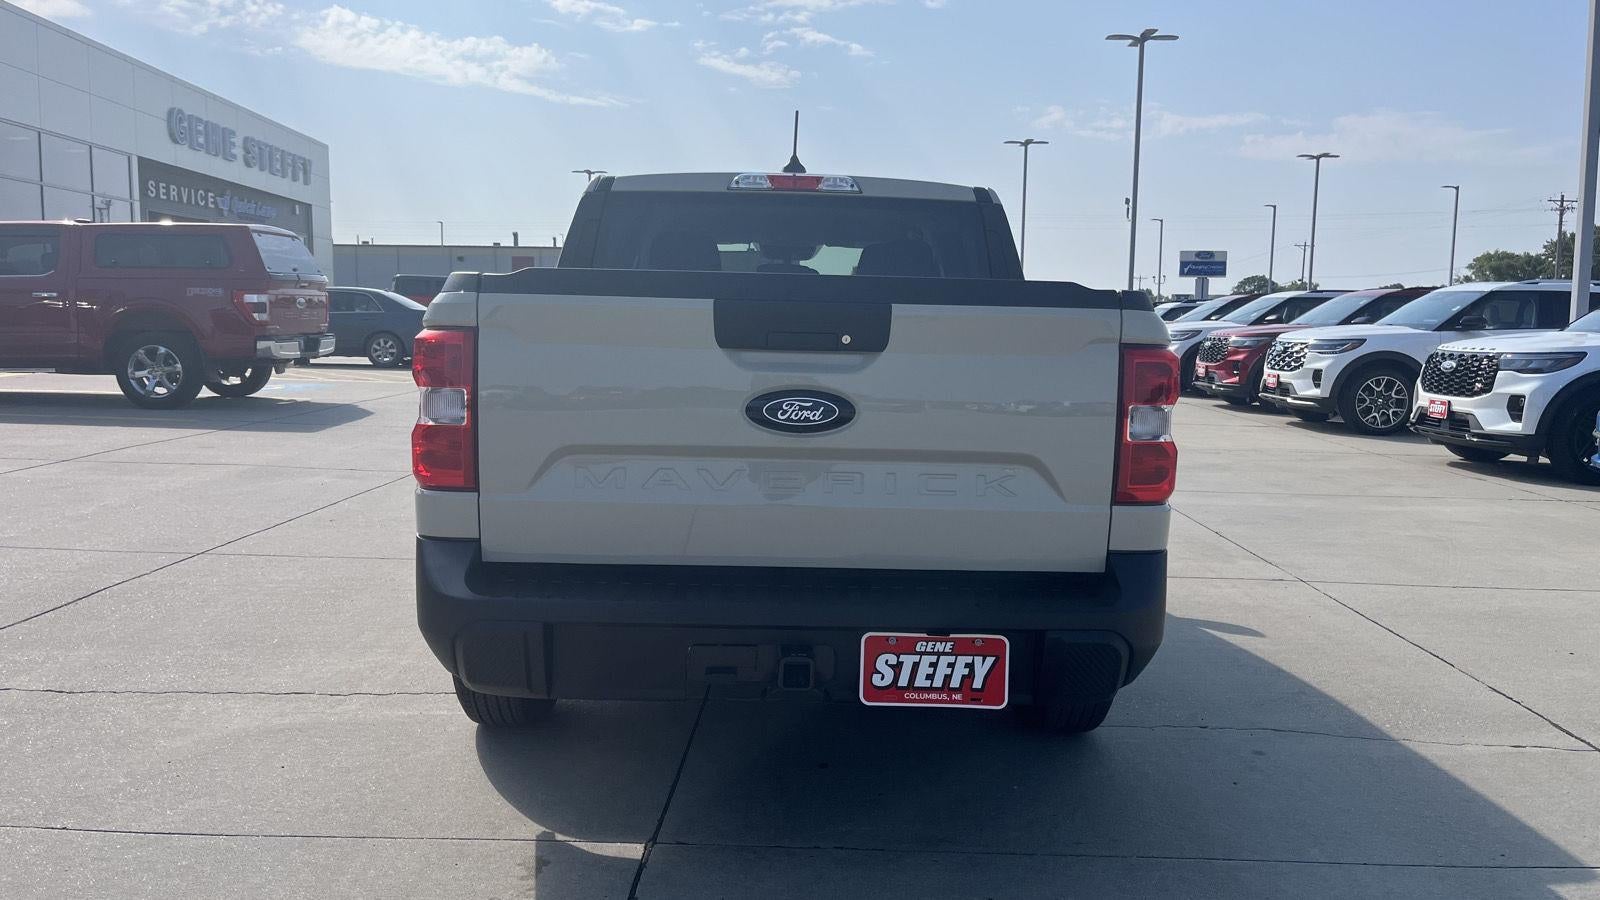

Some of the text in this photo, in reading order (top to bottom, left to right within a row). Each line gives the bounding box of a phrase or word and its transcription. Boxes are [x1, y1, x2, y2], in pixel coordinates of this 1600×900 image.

[167, 107, 312, 185] GENE STEFFY
[148, 180, 215, 208] SERVICE
[776, 400, 824, 422] Ford
[573, 464, 1018, 498] MAVERICK
[915, 641, 955, 653] GENE
[871, 653, 996, 690] STEFFY
[904, 692, 963, 701] COLUMBUS, NE
